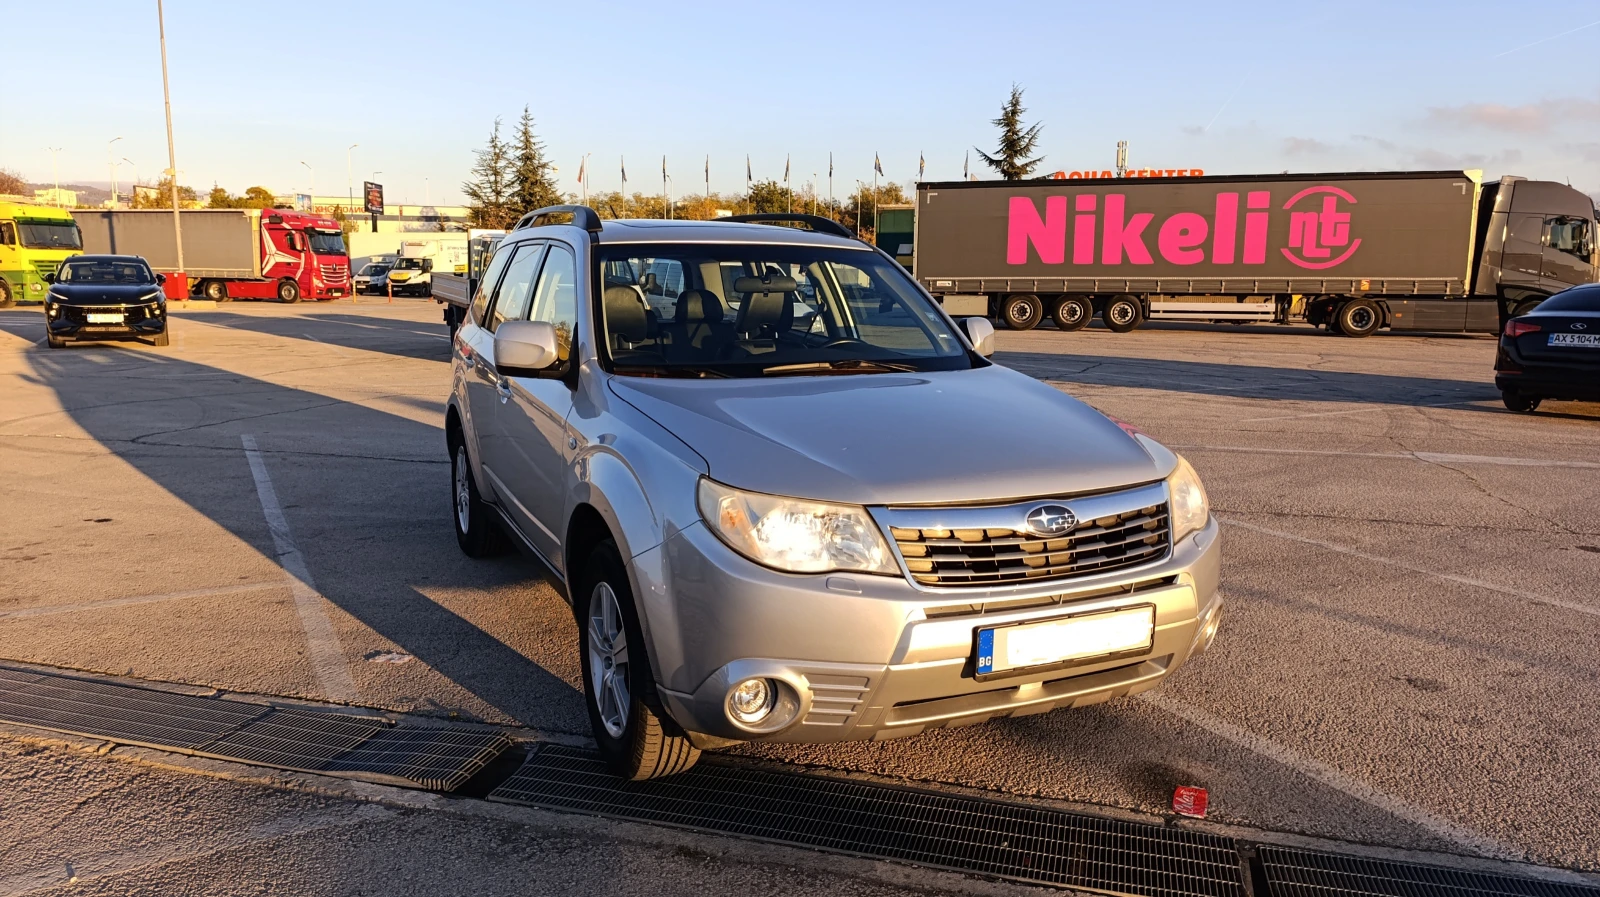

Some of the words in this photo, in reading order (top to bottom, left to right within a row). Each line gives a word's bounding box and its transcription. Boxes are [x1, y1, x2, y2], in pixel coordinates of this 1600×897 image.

[1007, 192, 1271, 265] Nikeli
[1554, 334, 1568, 343] AX
[1569, 335, 1592, 344] 5104
[979, 655, 992, 667] BG
